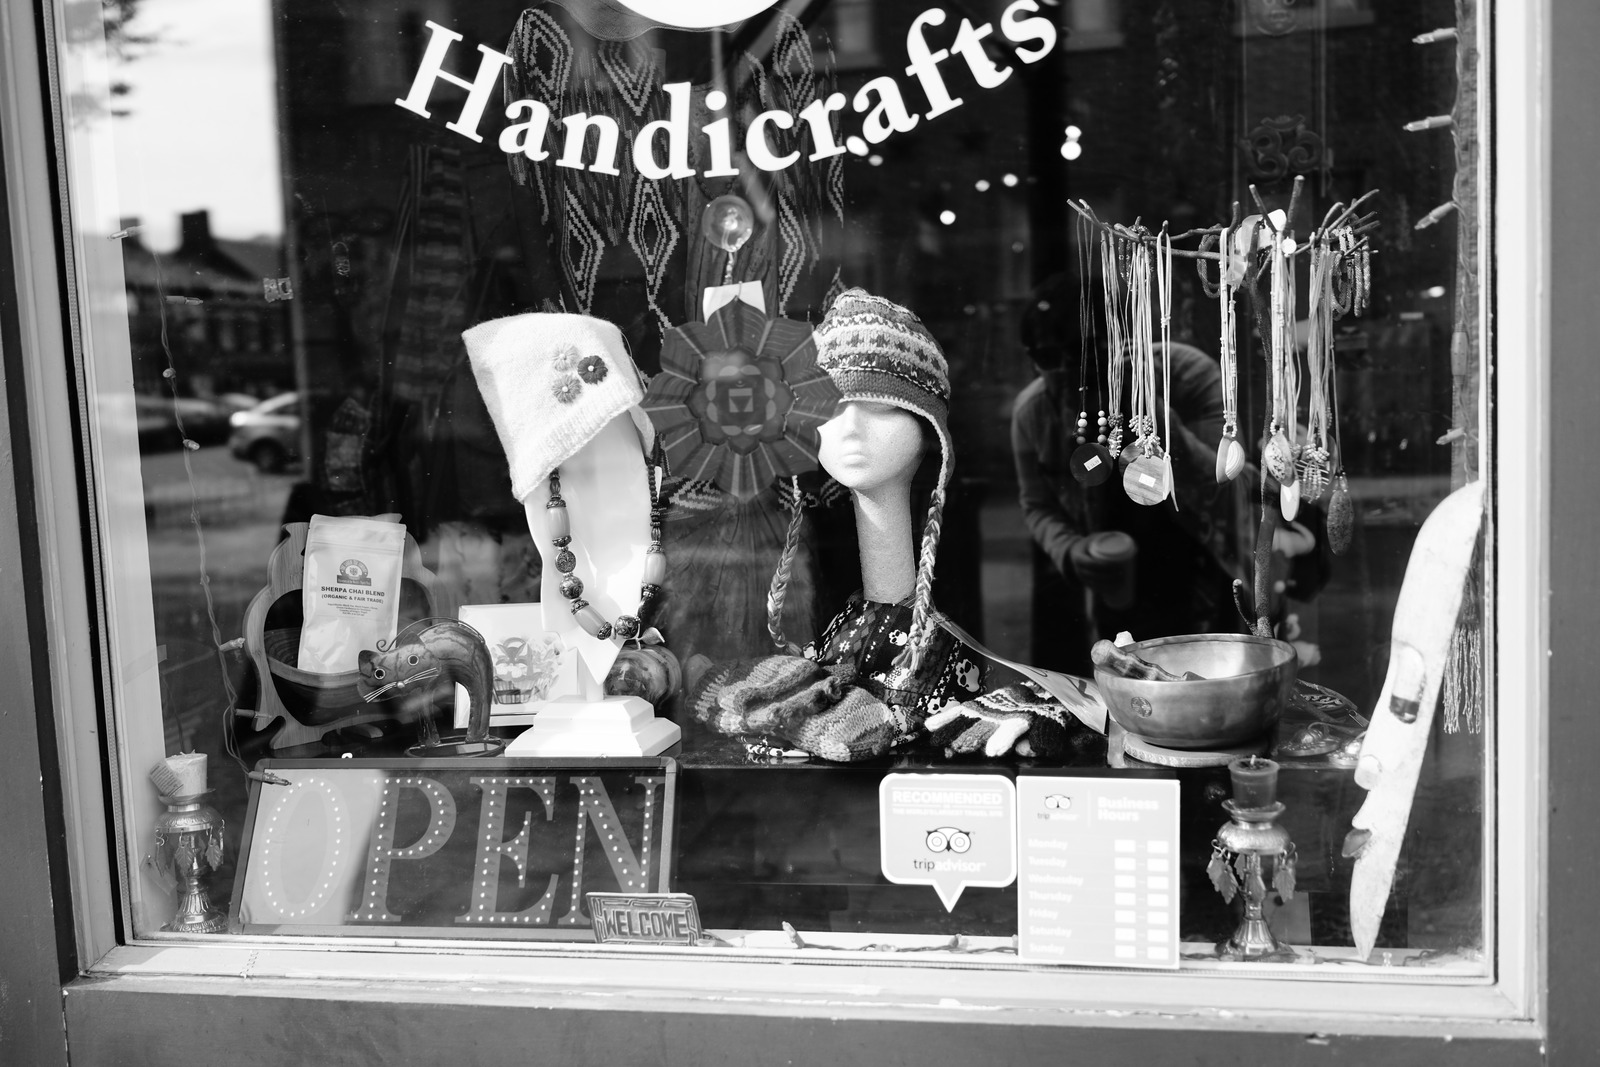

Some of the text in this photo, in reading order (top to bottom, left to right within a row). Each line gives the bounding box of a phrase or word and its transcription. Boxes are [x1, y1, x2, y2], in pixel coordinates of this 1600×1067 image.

[394, 0, 1057, 180] Handicrafts
[892, 790, 1002, 805] RECOMMENDED
[1097, 795, 1160, 811] Business
[1097, 808, 1140, 822] Hours
[257, 774, 667, 925] OPEN
[1027, 838, 1069, 851] Monday
[1027, 856, 1068, 869] Tuesday
[1028, 873, 1085, 887] Wednesday
[1028, 890, 1073, 904] Thursday
[1028, 907, 1060, 921] Friday
[602, 908, 689, 938] WELCOME
[1029, 925, 1072, 938] Saturday
[1029, 942, 1065, 956] Sunday
